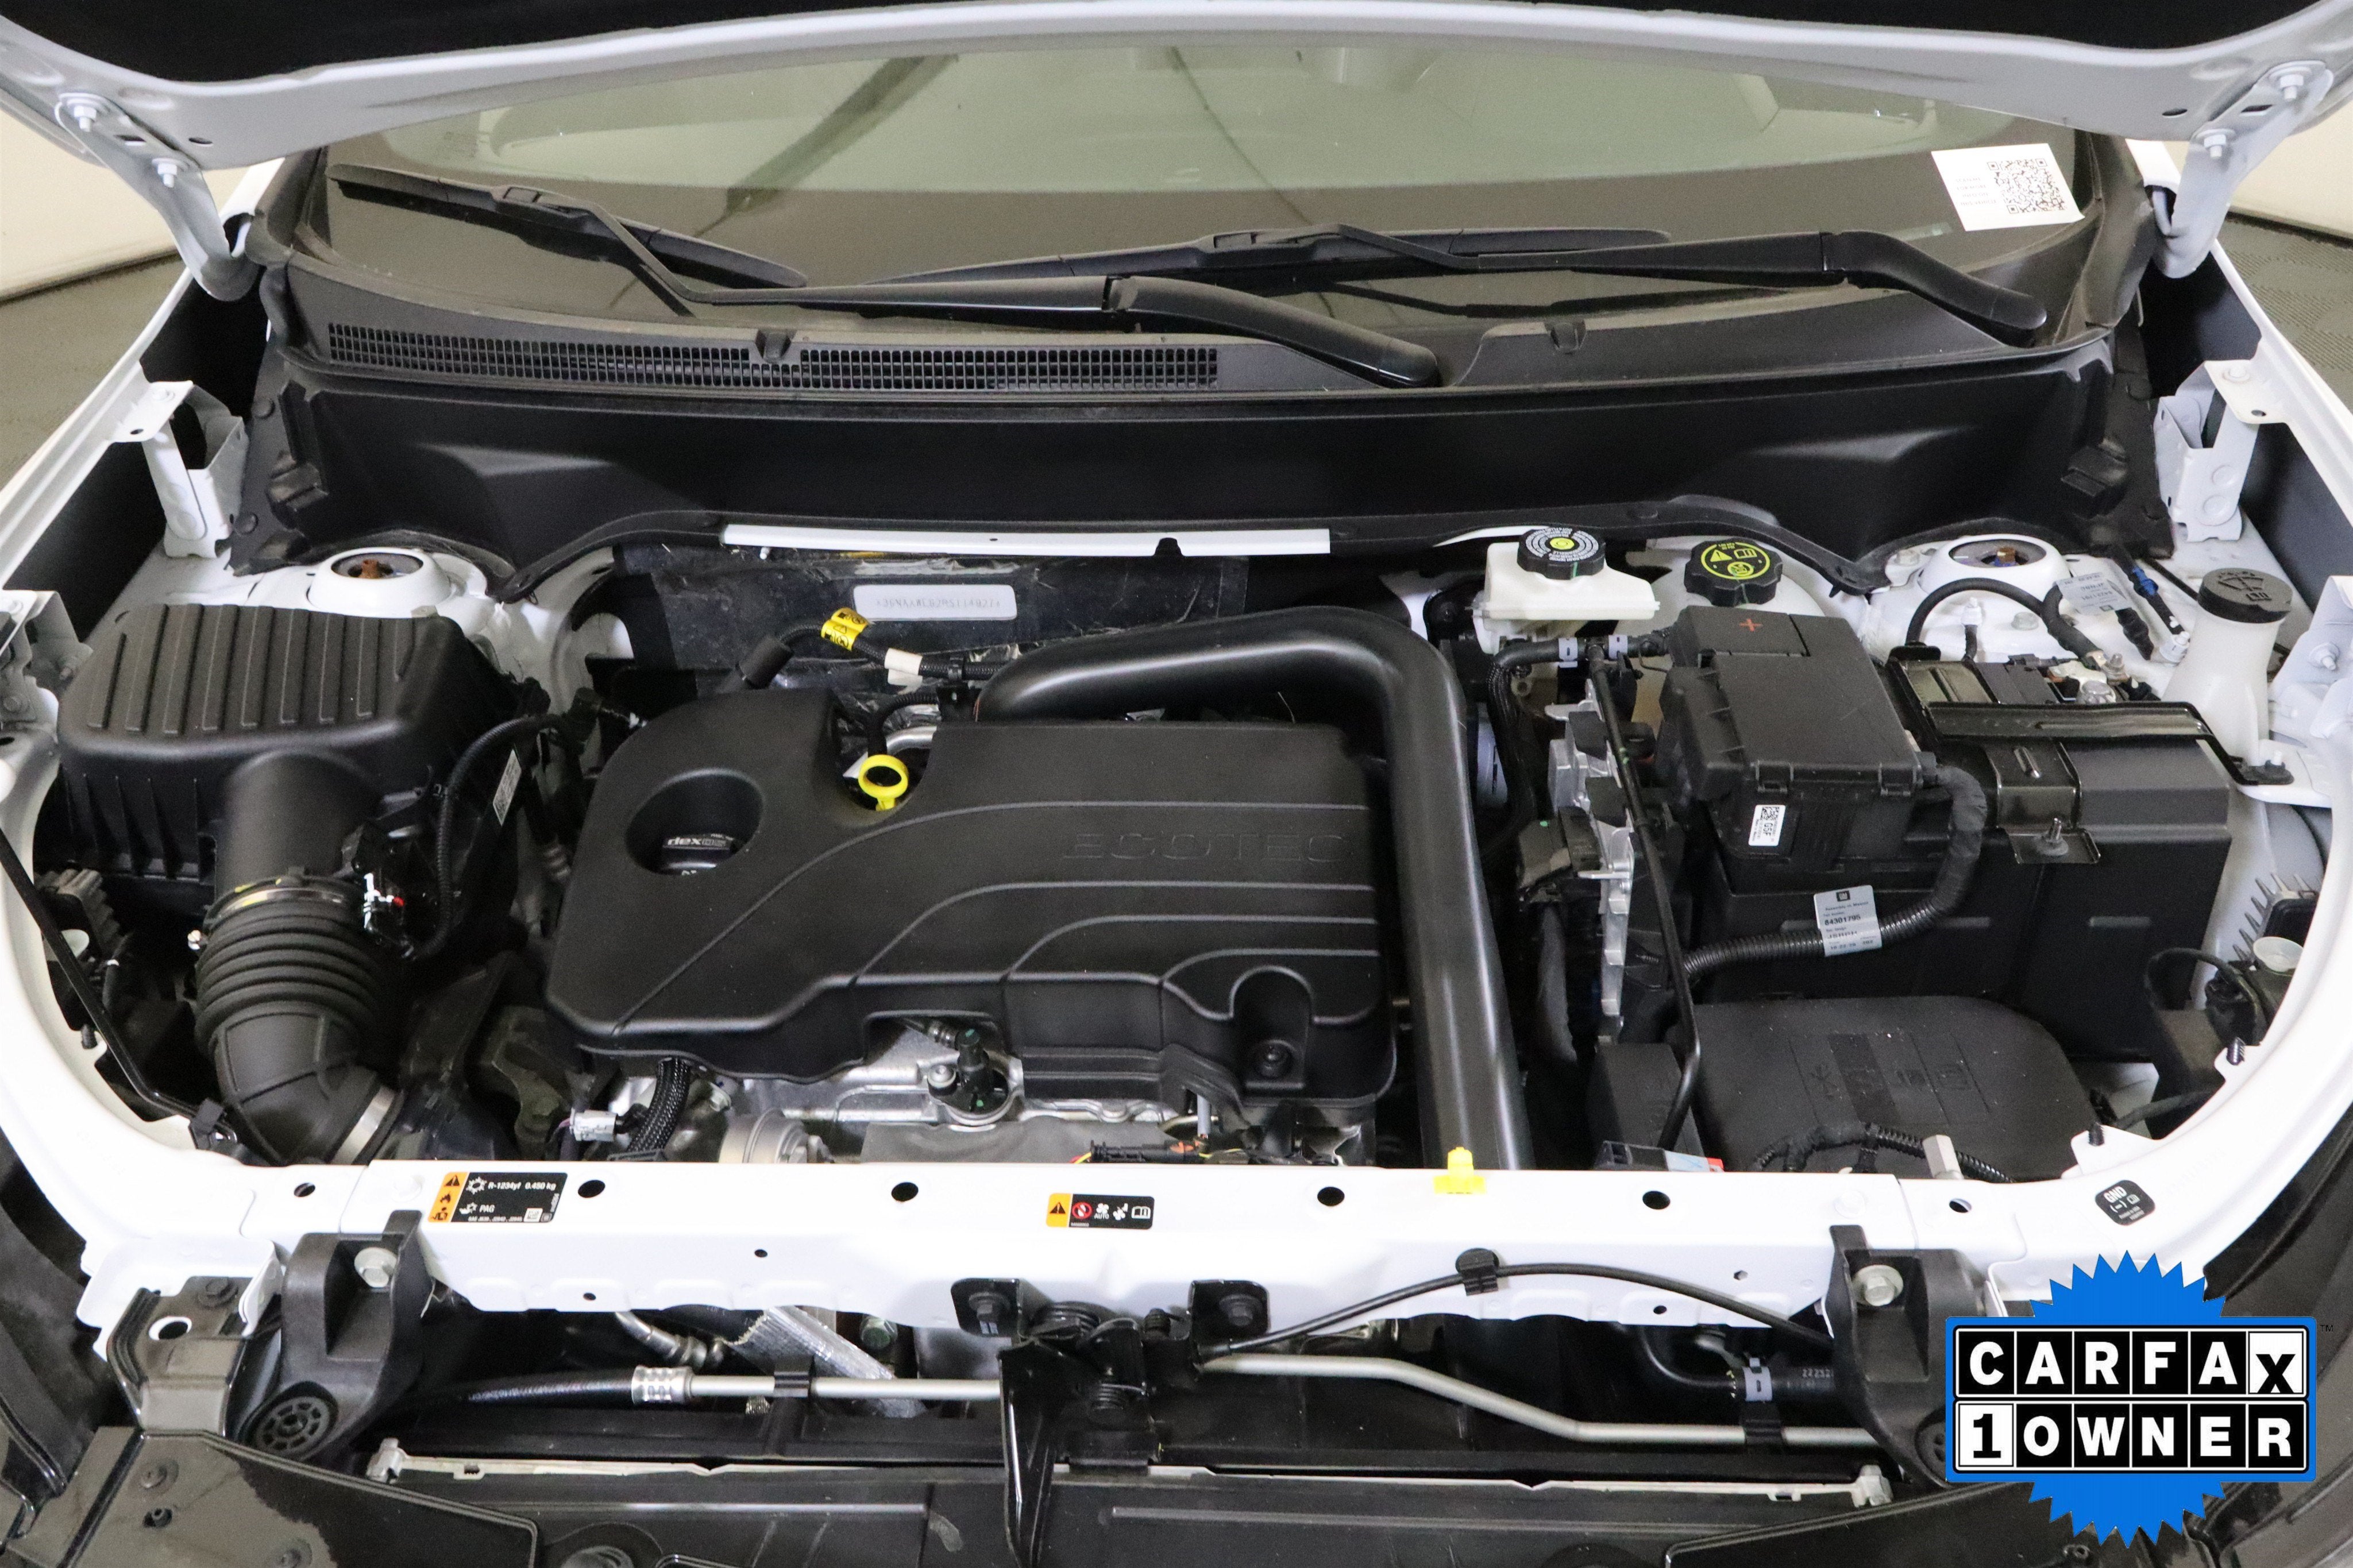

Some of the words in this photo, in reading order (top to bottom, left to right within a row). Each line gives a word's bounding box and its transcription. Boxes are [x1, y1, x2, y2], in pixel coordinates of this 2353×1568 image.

[546, 1182, 557, 1191] kg
[2103, 1185, 2128, 1203] GND
[479, 1204, 495, 1213] PAG
